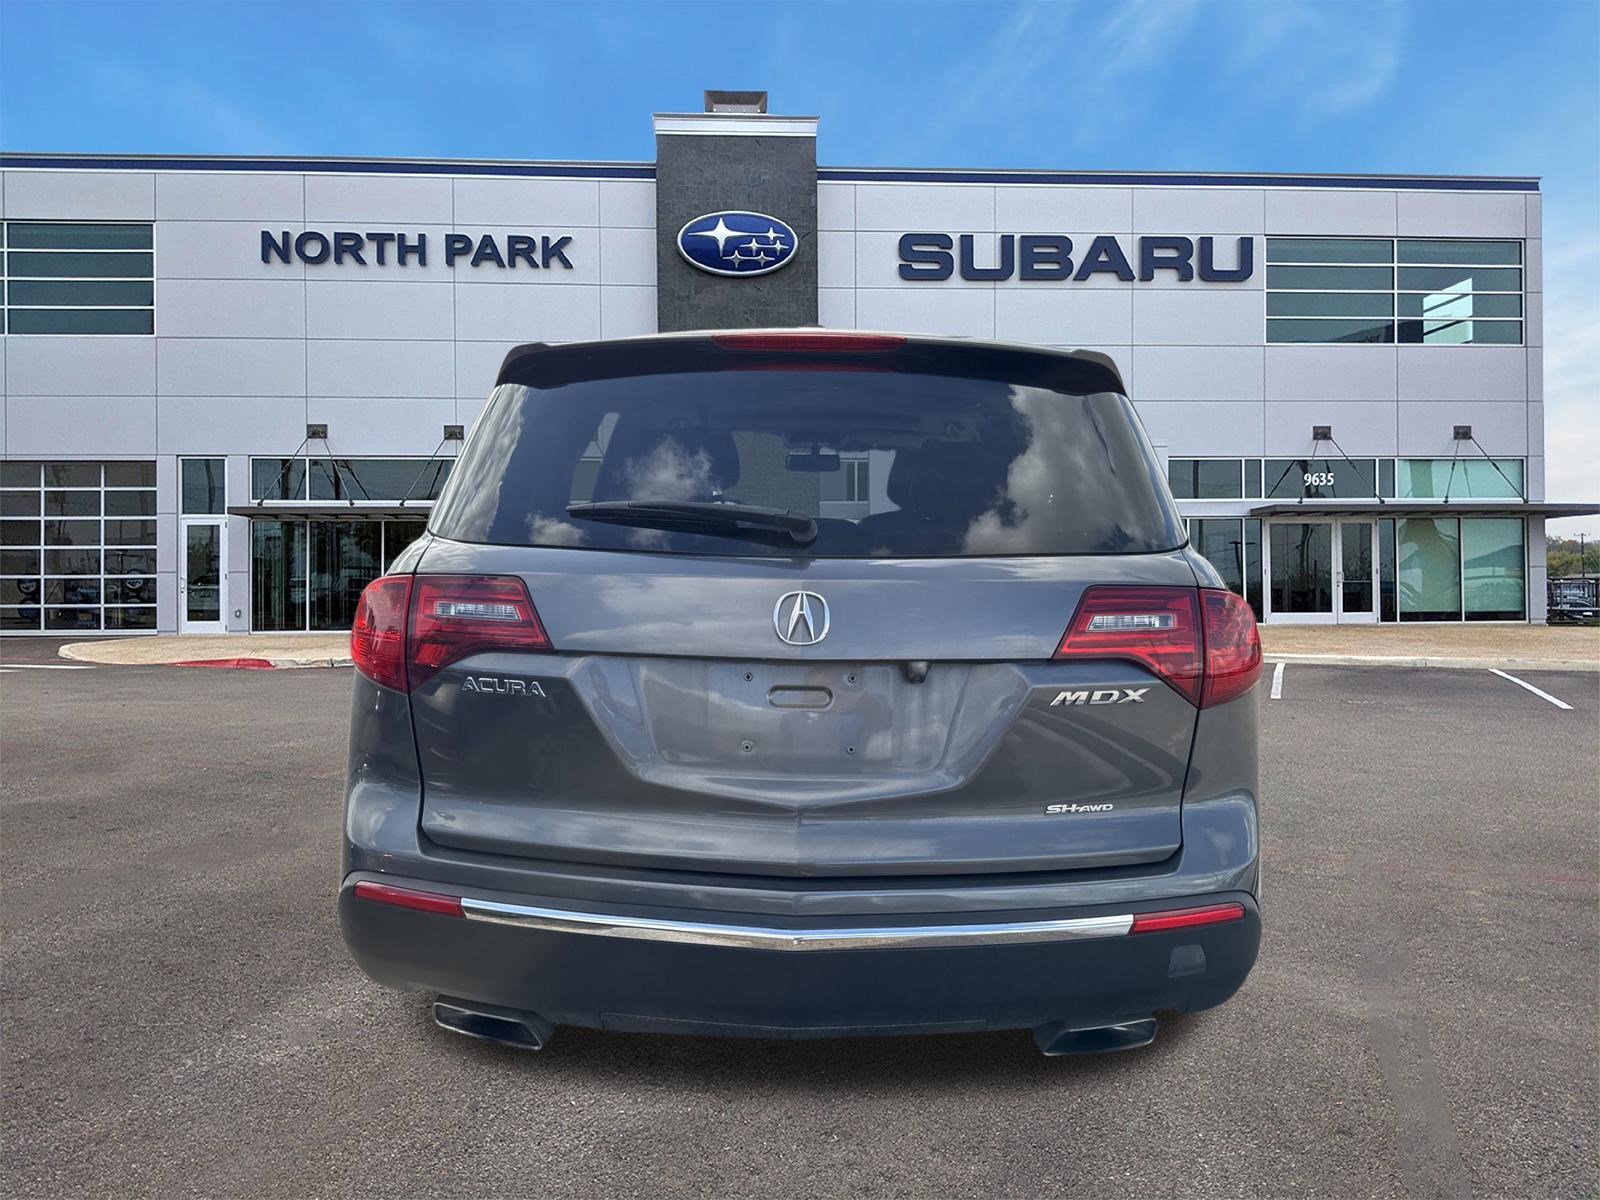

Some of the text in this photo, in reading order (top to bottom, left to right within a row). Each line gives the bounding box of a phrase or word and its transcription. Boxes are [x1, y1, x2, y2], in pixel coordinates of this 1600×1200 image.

[261, 230, 574, 269] NORTH PARK
[898, 233, 1254, 282] SUBARU
[1303, 472, 1335, 486] 9635
[462, 676, 546, 698] ACURA
[1049, 687, 1151, 706] MDX
[1045, 803, 1114, 814] SH-AWD
